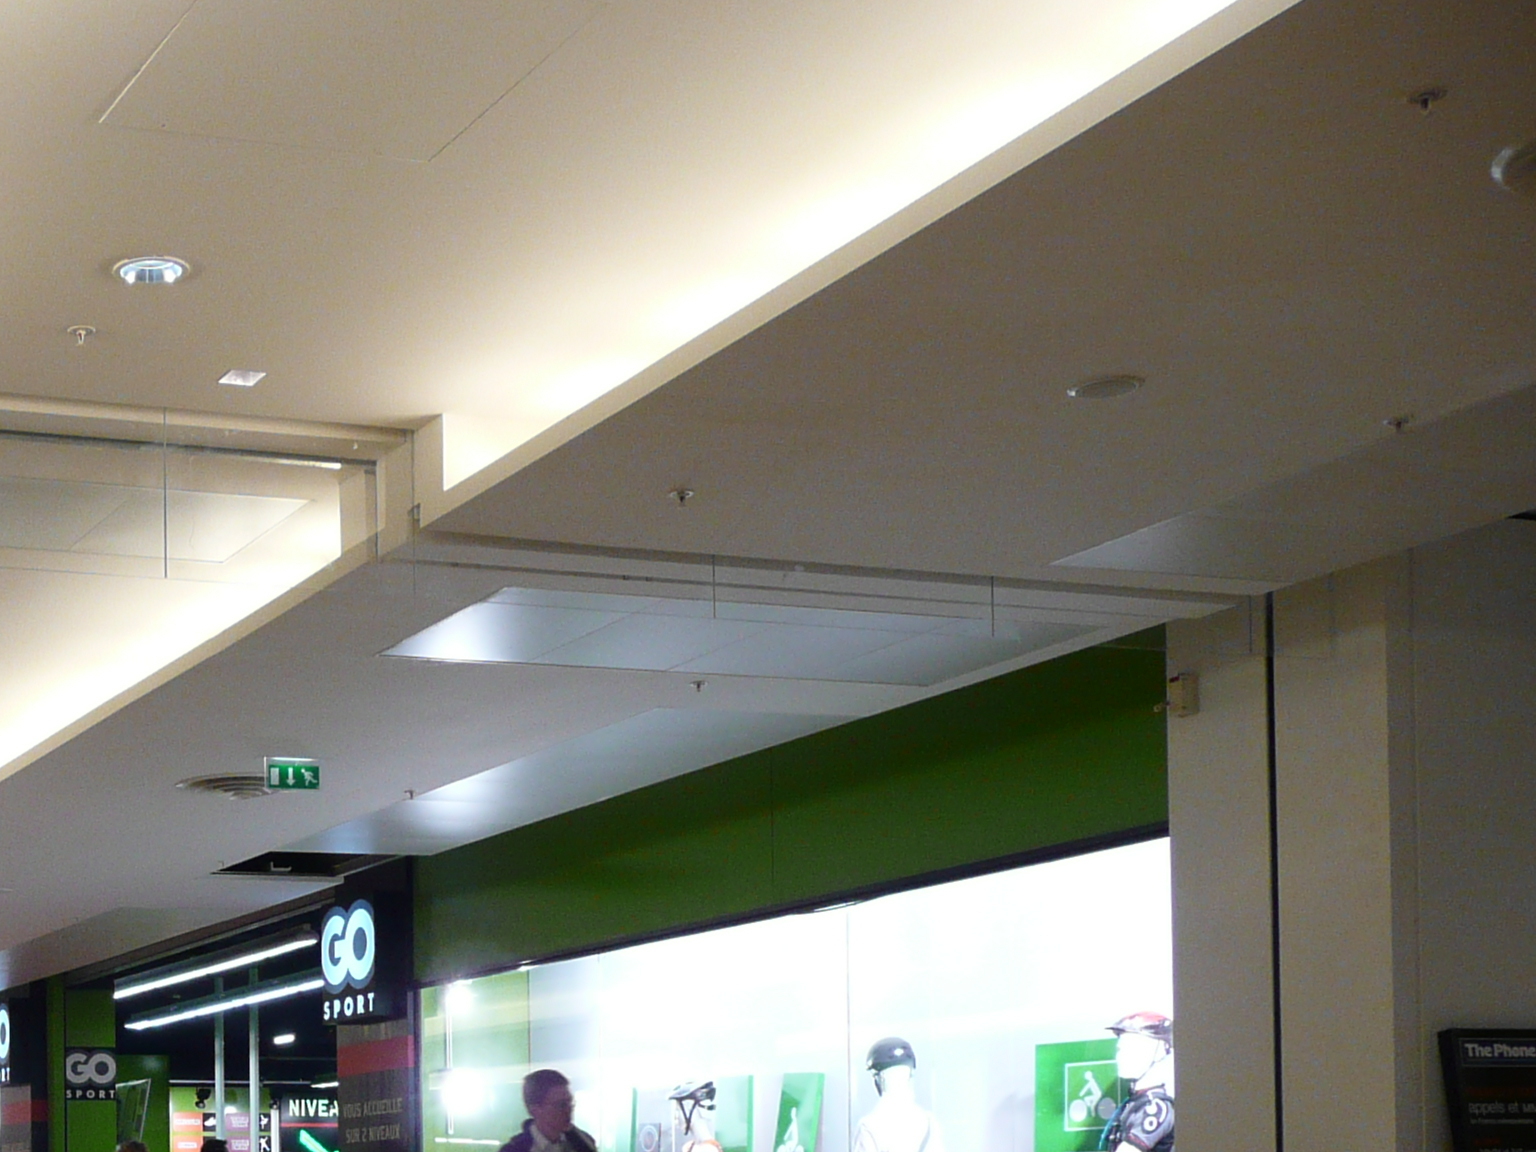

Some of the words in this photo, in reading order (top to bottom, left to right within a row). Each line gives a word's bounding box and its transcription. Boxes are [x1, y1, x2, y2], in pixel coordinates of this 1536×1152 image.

[321, 907, 376, 985] GO
[323, 993, 375, 1020] SPORT
[1464, 1043, 1492, 1058] The
[65, 1053, 116, 1084] GO
[66, 1089, 115, 1099] SPORT
[288, 1098, 339, 1118] NIVEA
